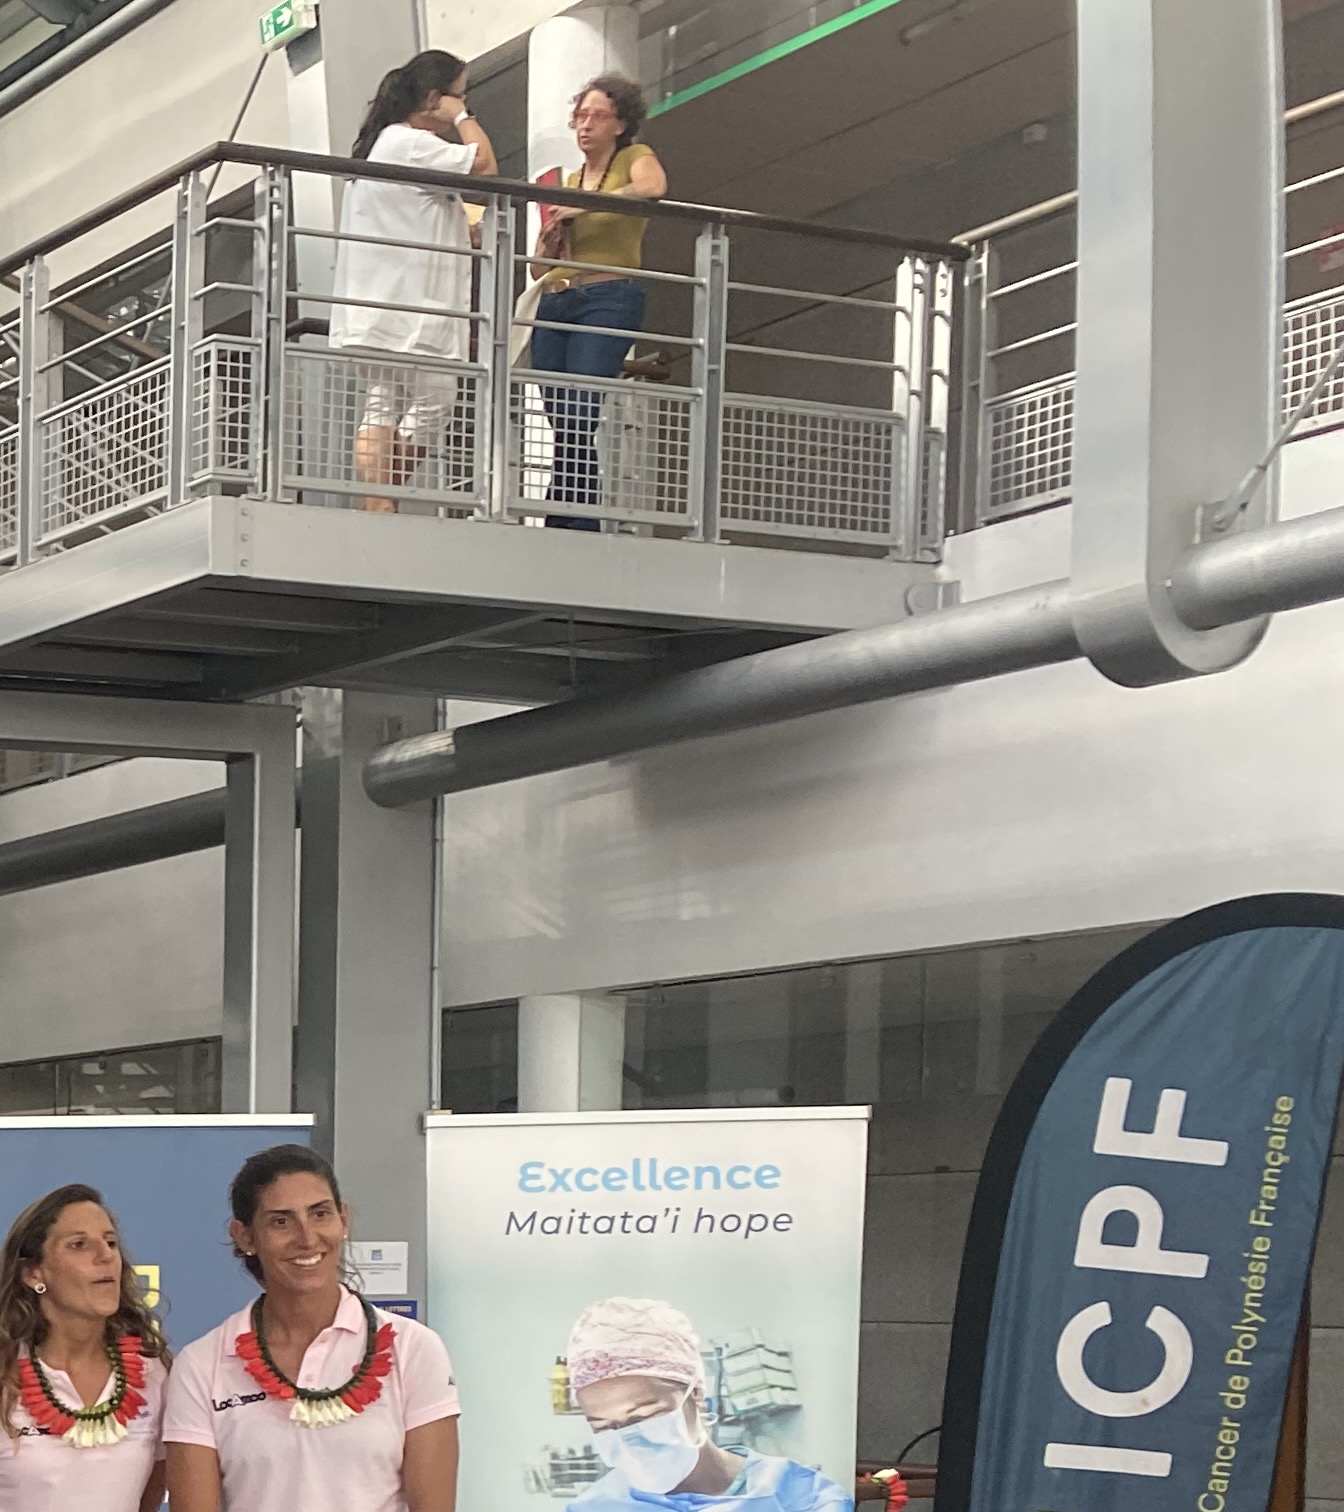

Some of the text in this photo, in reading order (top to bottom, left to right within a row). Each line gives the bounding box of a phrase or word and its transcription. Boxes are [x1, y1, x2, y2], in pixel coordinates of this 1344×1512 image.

[518, 1157, 781, 1193] Excellence
[1250, 1095, 1295, 1227] Française
[505, 1207, 793, 1239] Maitata'i hope
[1043, 1077, 1229, 1478] ICPF
[1225, 1236, 1271, 1366] Polynésie
[1219, 1374, 1250, 1409] de
